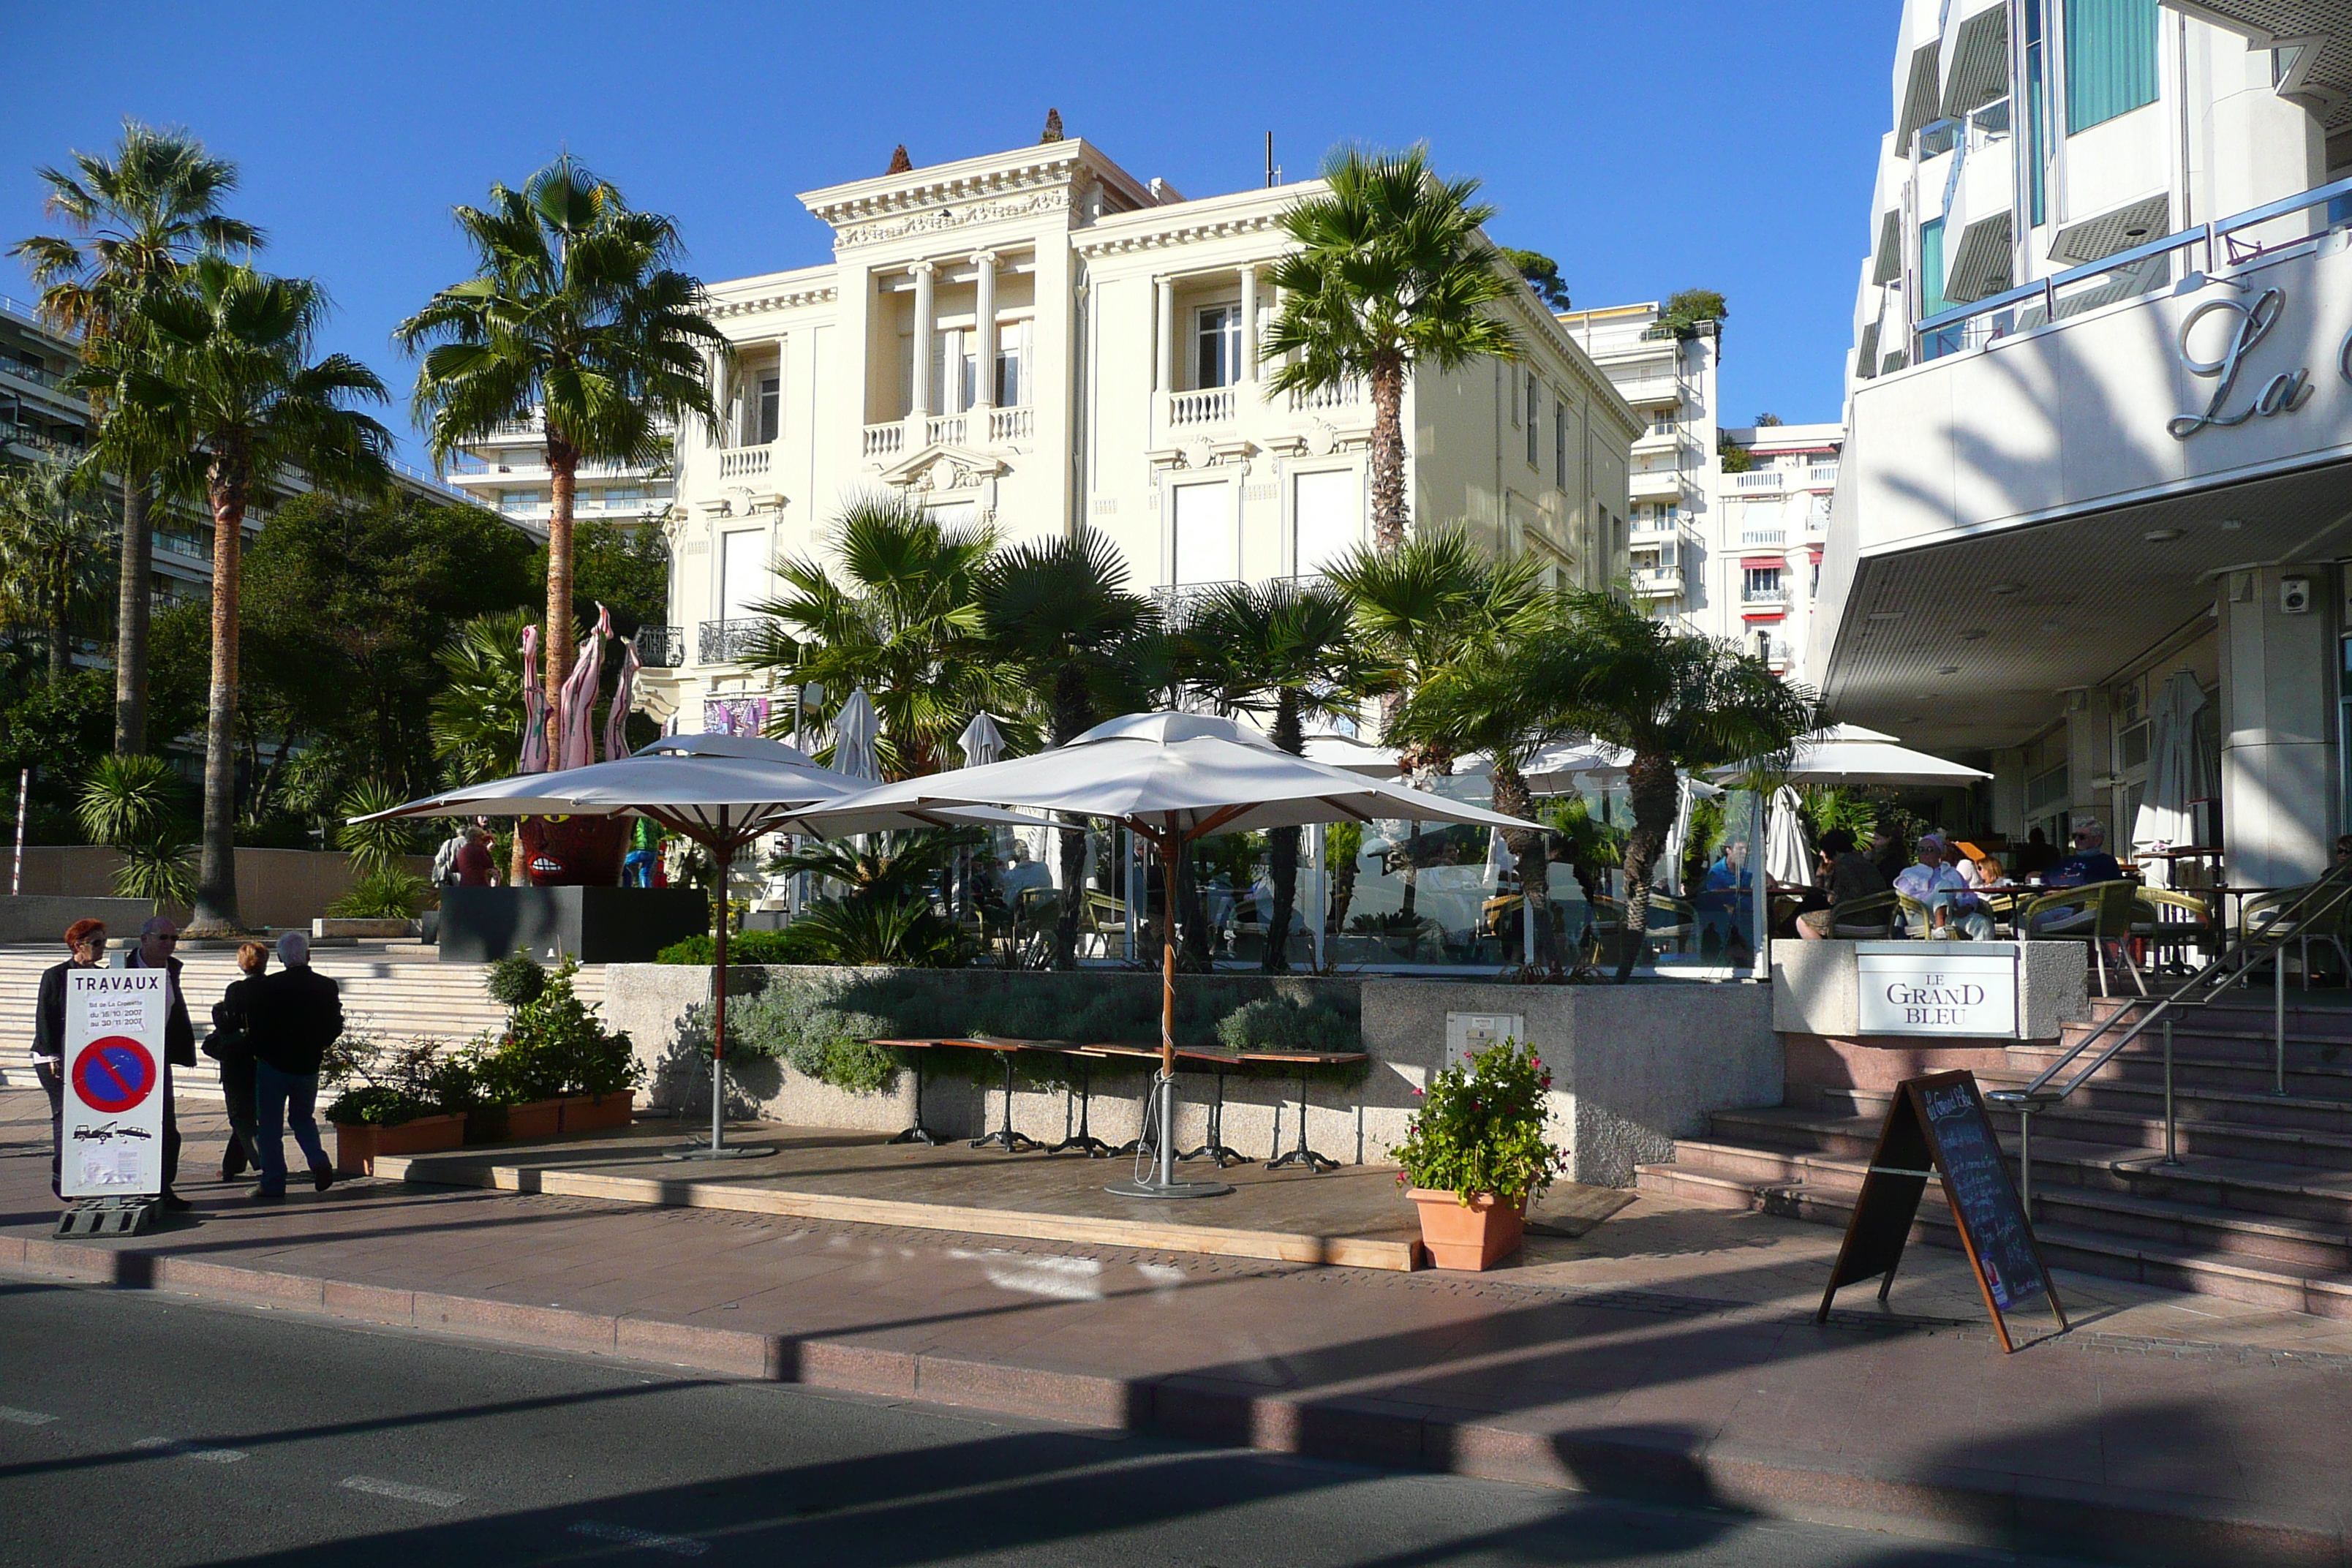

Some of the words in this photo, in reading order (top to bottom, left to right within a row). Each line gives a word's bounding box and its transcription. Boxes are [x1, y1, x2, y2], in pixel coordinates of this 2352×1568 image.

[2166, 287, 2315, 441] La
[75, 976, 159, 990] TRAVAUX
[1926, 974, 1945, 986] LE
[1886, 983, 1985, 1006] GRAND
[1904, 1008, 1967, 1025] BLEU
